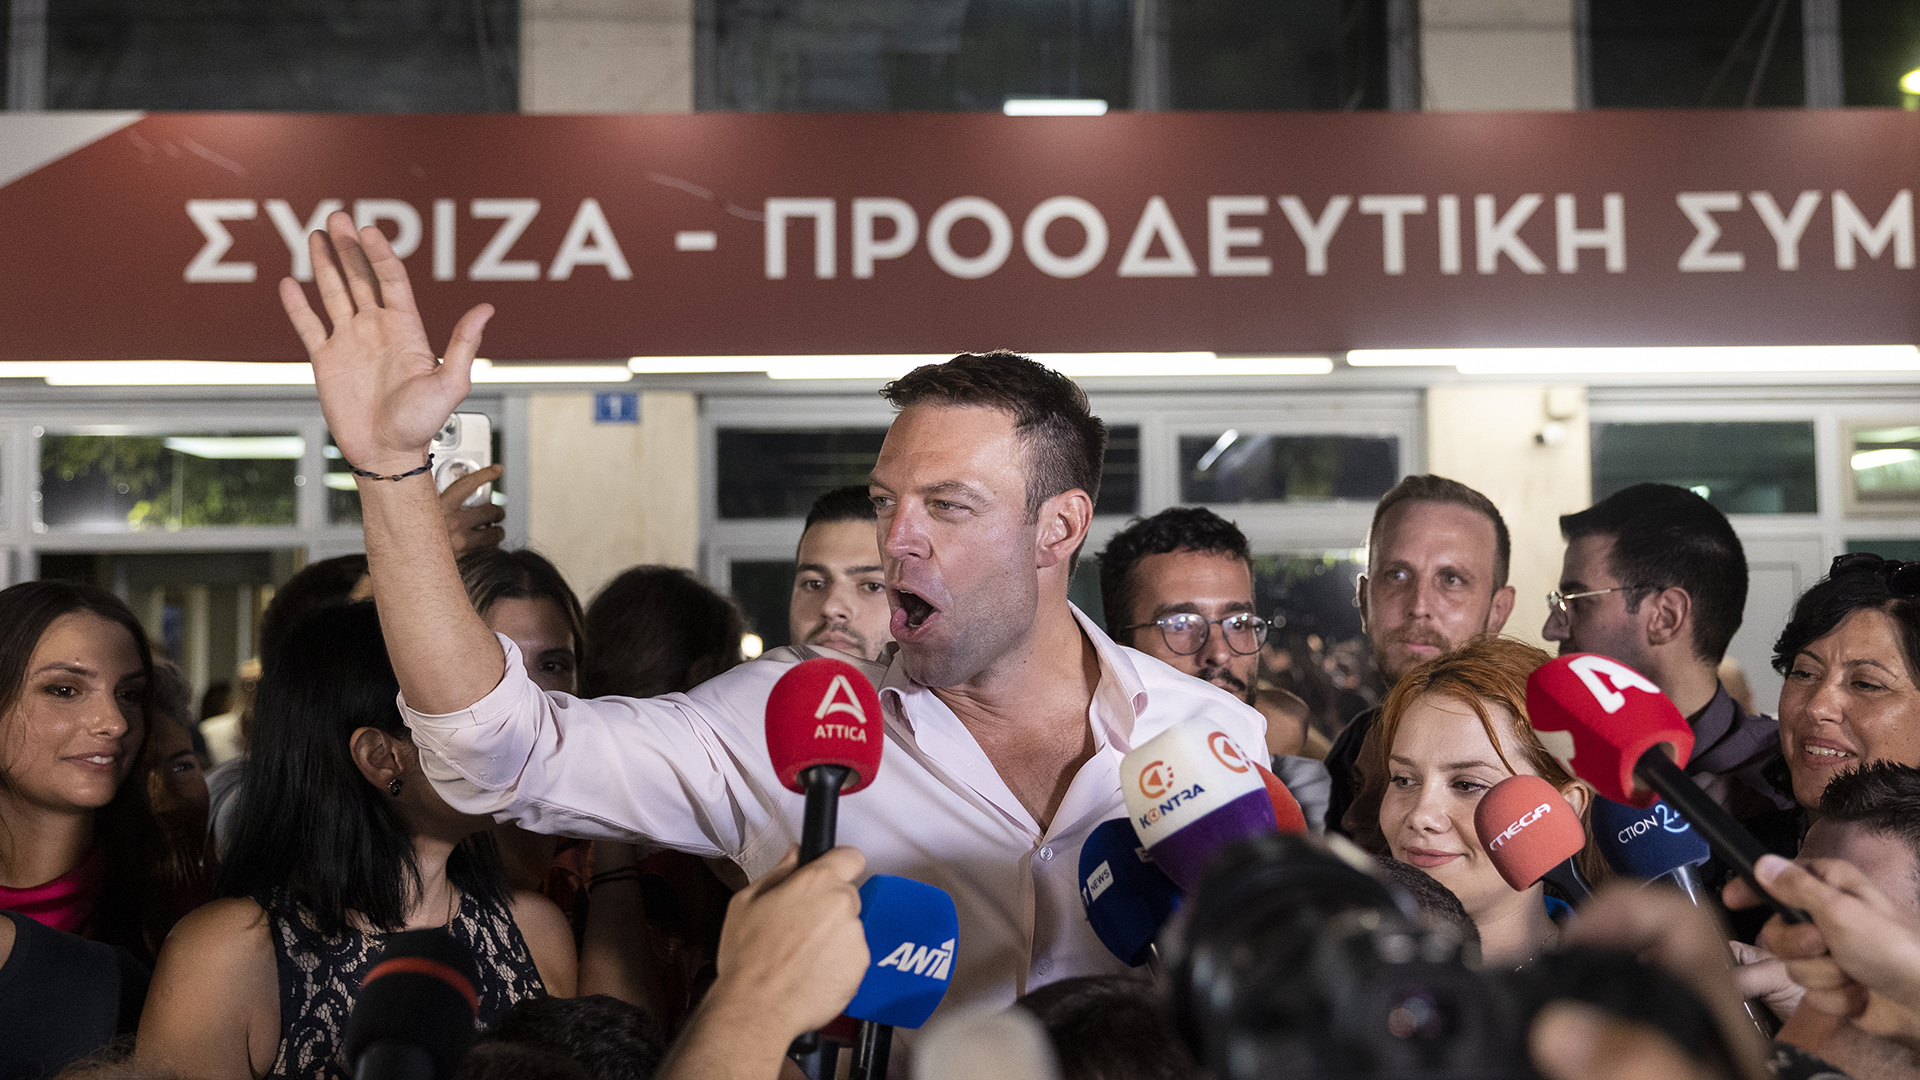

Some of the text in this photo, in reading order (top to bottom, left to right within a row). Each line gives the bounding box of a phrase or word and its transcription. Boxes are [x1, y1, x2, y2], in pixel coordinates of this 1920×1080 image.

[183, 199, 632, 283] ΣΥΡΙΖΑ
[765, 193, 1627, 280] ΠΡΟΟΔΕΥΤΙΚΗ
[1675, 189, 1917, 273] ΣΥΜ
[814, 724, 867, 744] ATTICA
[1139, 783, 1205, 829] KONTRA
[1489, 803, 1551, 851] MEGA
[1090, 869, 1110, 892] NEWS
